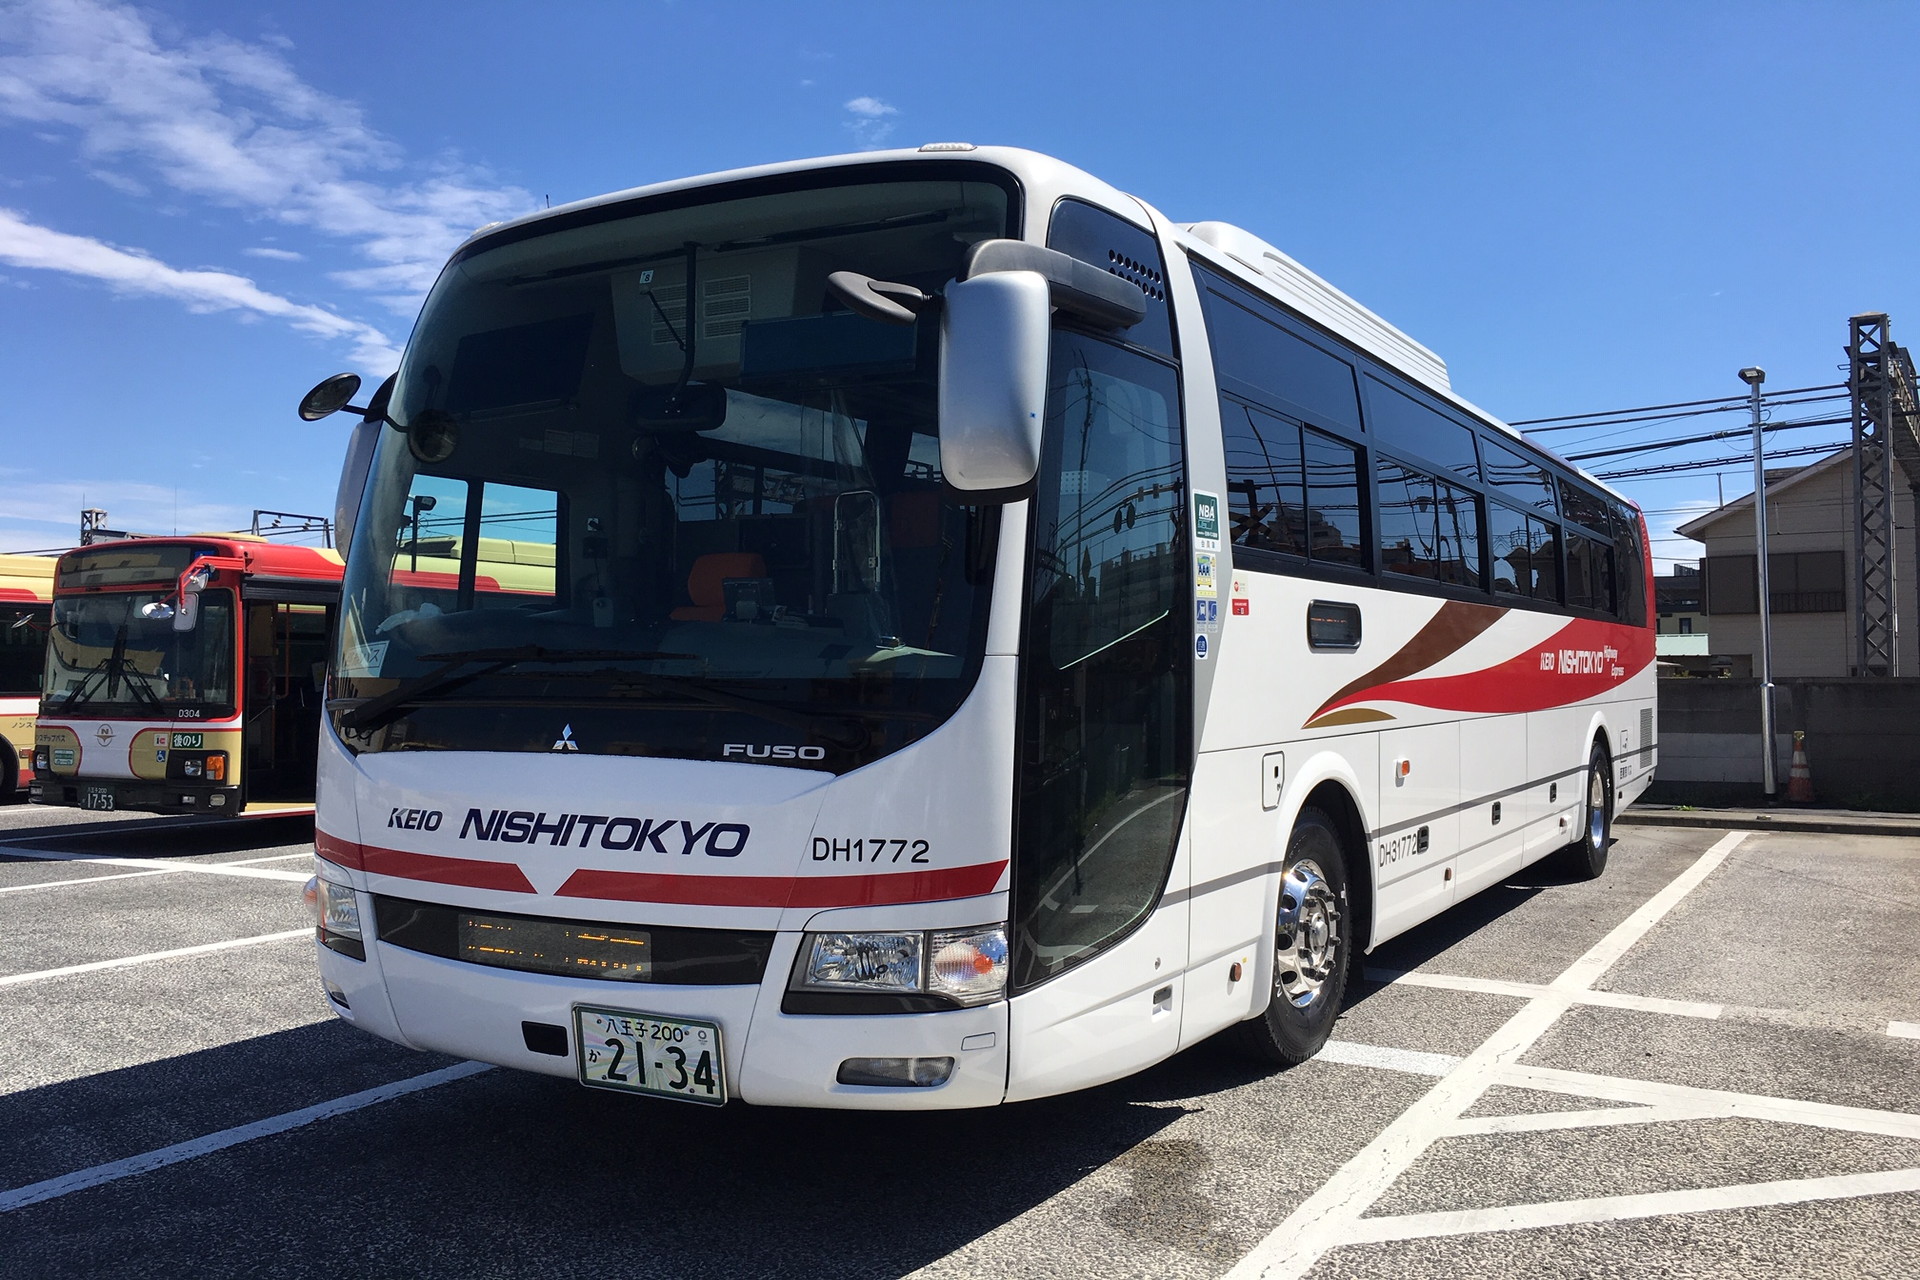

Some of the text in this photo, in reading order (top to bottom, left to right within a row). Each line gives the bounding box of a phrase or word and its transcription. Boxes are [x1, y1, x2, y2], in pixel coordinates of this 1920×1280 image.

[1199, 503, 1215, 519] NBA
[1540, 652, 1555, 671] KEIO
[1558, 649, 1604, 674] NISHITOKYO
[174, 734, 202, 747] 後のり
[723, 743, 825, 760] FUSO
[387, 807, 751, 857] KEIO NISHITOKYO
[812, 837, 930, 863] DH1772
[1379, 833, 1417, 867] DH31772
[588, 1038, 716, 1094] か 21-34
